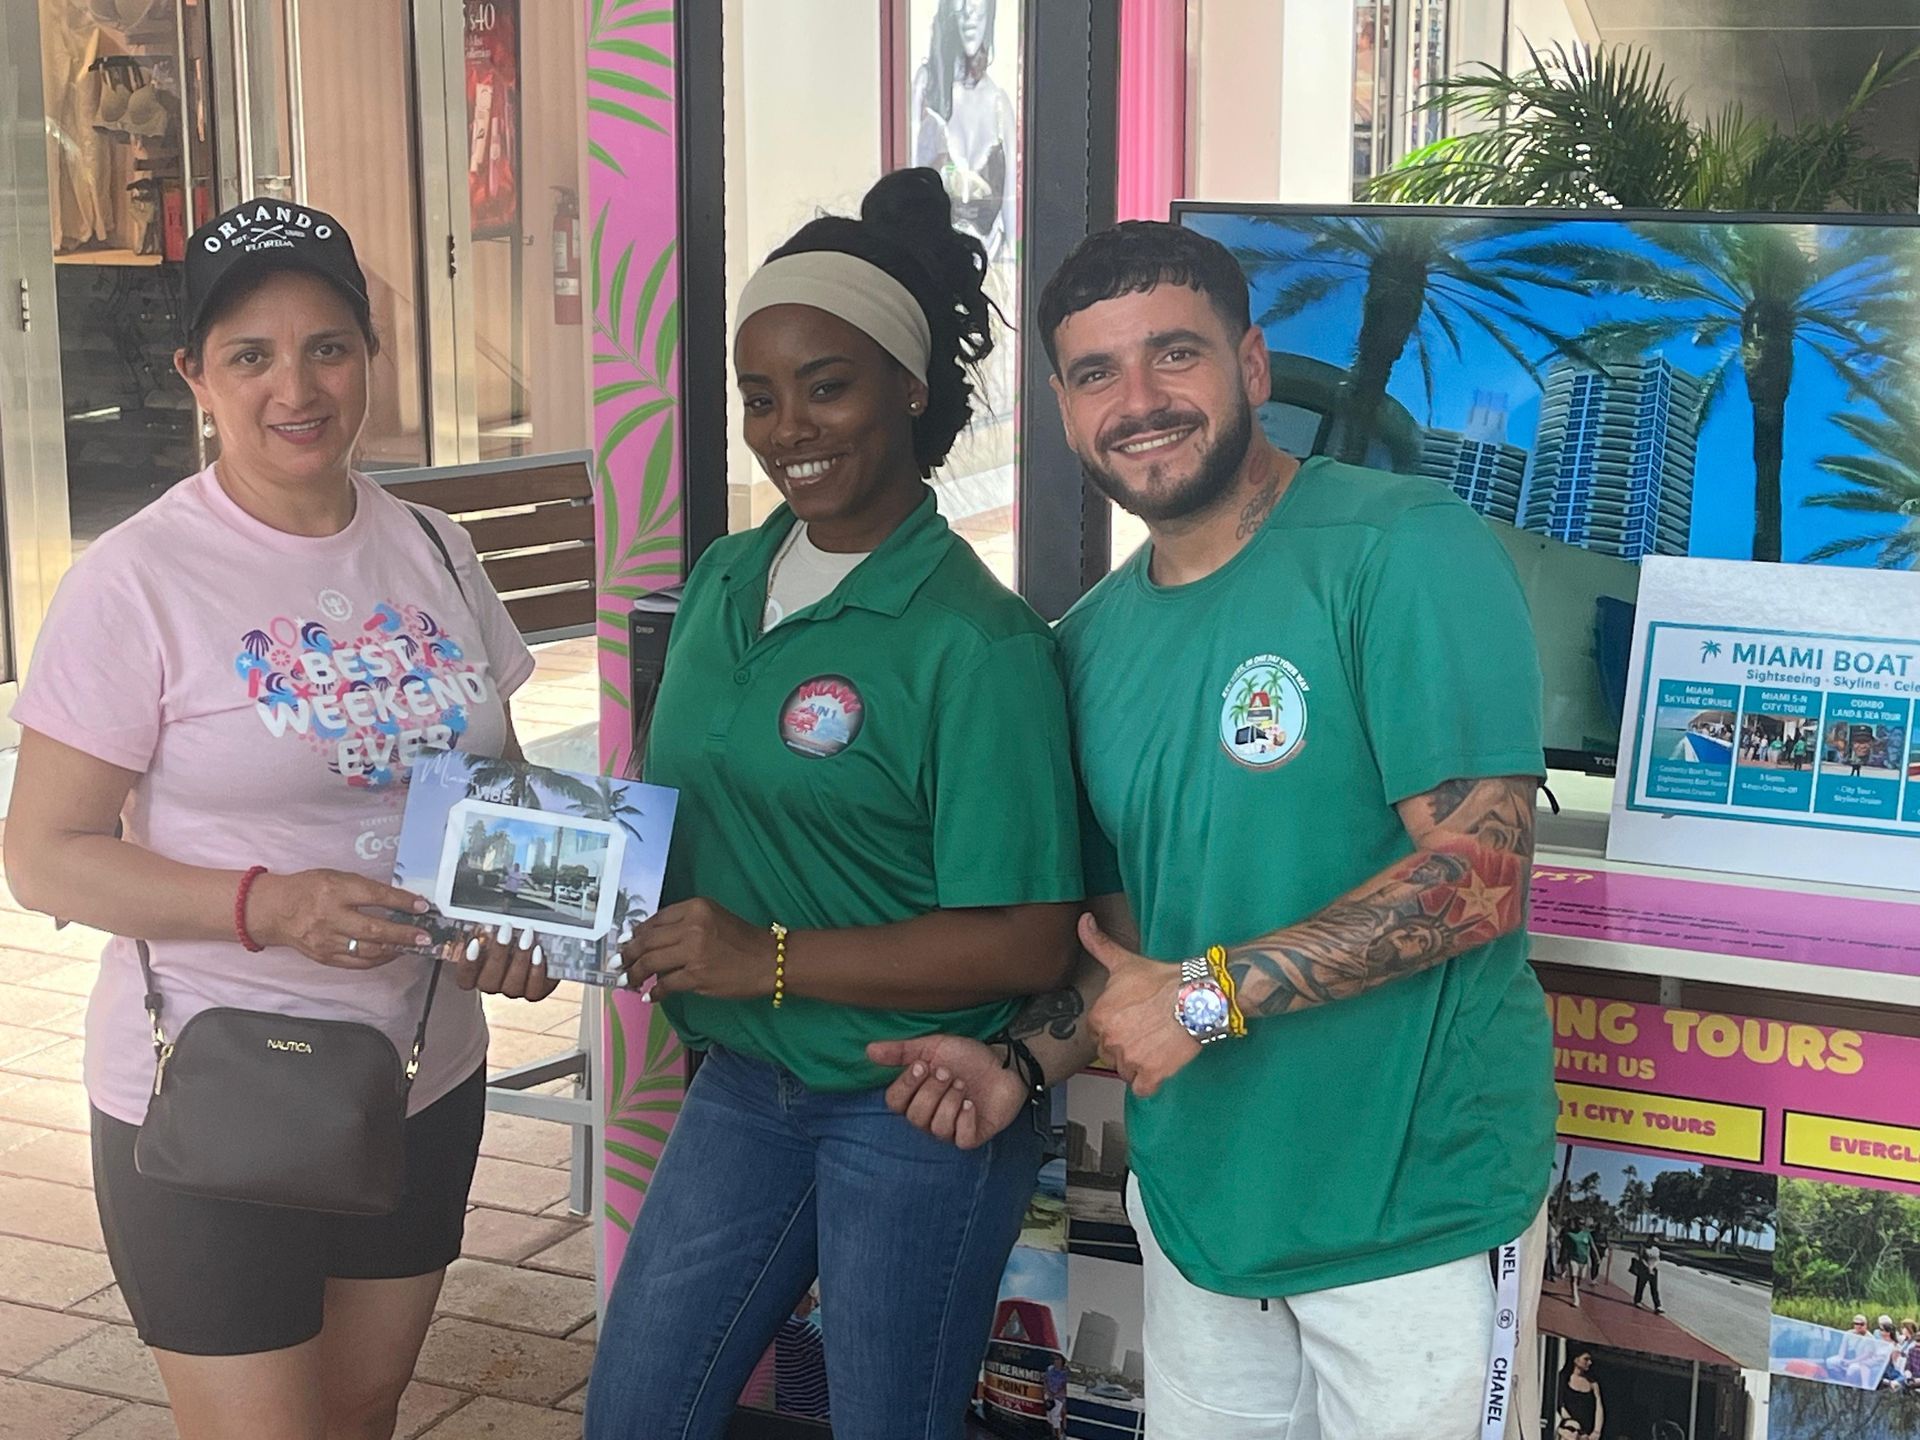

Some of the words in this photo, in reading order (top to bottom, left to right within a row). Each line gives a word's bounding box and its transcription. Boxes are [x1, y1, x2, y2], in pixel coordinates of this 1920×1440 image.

[204, 205, 332, 253] ORLANDO
[245, 239, 295, 252] FLORIDA
[301, 638, 414, 685] BEST
[1732, 642, 1823, 671] MIAMI
[1833, 650, 1914, 677] BOAT
[1686, 685, 1714, 695] MIAMI
[1746, 669, 1821, 687] Sightseeing
[1833, 676, 1880, 690] Skyline
[256, 671, 488, 737] WEEKEND
[799, 681, 861, 715] MIAMI
[1664, 694, 1701, 705] SKYLINE
[1702, 698, 1732, 708] CRUISE
[1761, 692, 1790, 702] MIAMI
[1762, 702, 1781, 712] CITY
[1783, 703, 1807, 714] TOUR
[1851, 699, 1884, 709] COMBO
[1832, 709, 1856, 718] LAND
[1864, 711, 1879, 719] SEA
[1881, 712, 1901, 721] TOUR
[338, 723, 454, 777] EVER
[267, 1039, 313, 1053] NAUTICA
[1664, 1010, 1864, 1075] TOURS
[1617, 1056, 1656, 1080] US
[1584, 1104, 1634, 1125] CITY
[1643, 1111, 1717, 1136] TOURS
[1001, 1379, 1029, 1396] POINT
[1487, 1357, 1508, 1426] CHANEL
